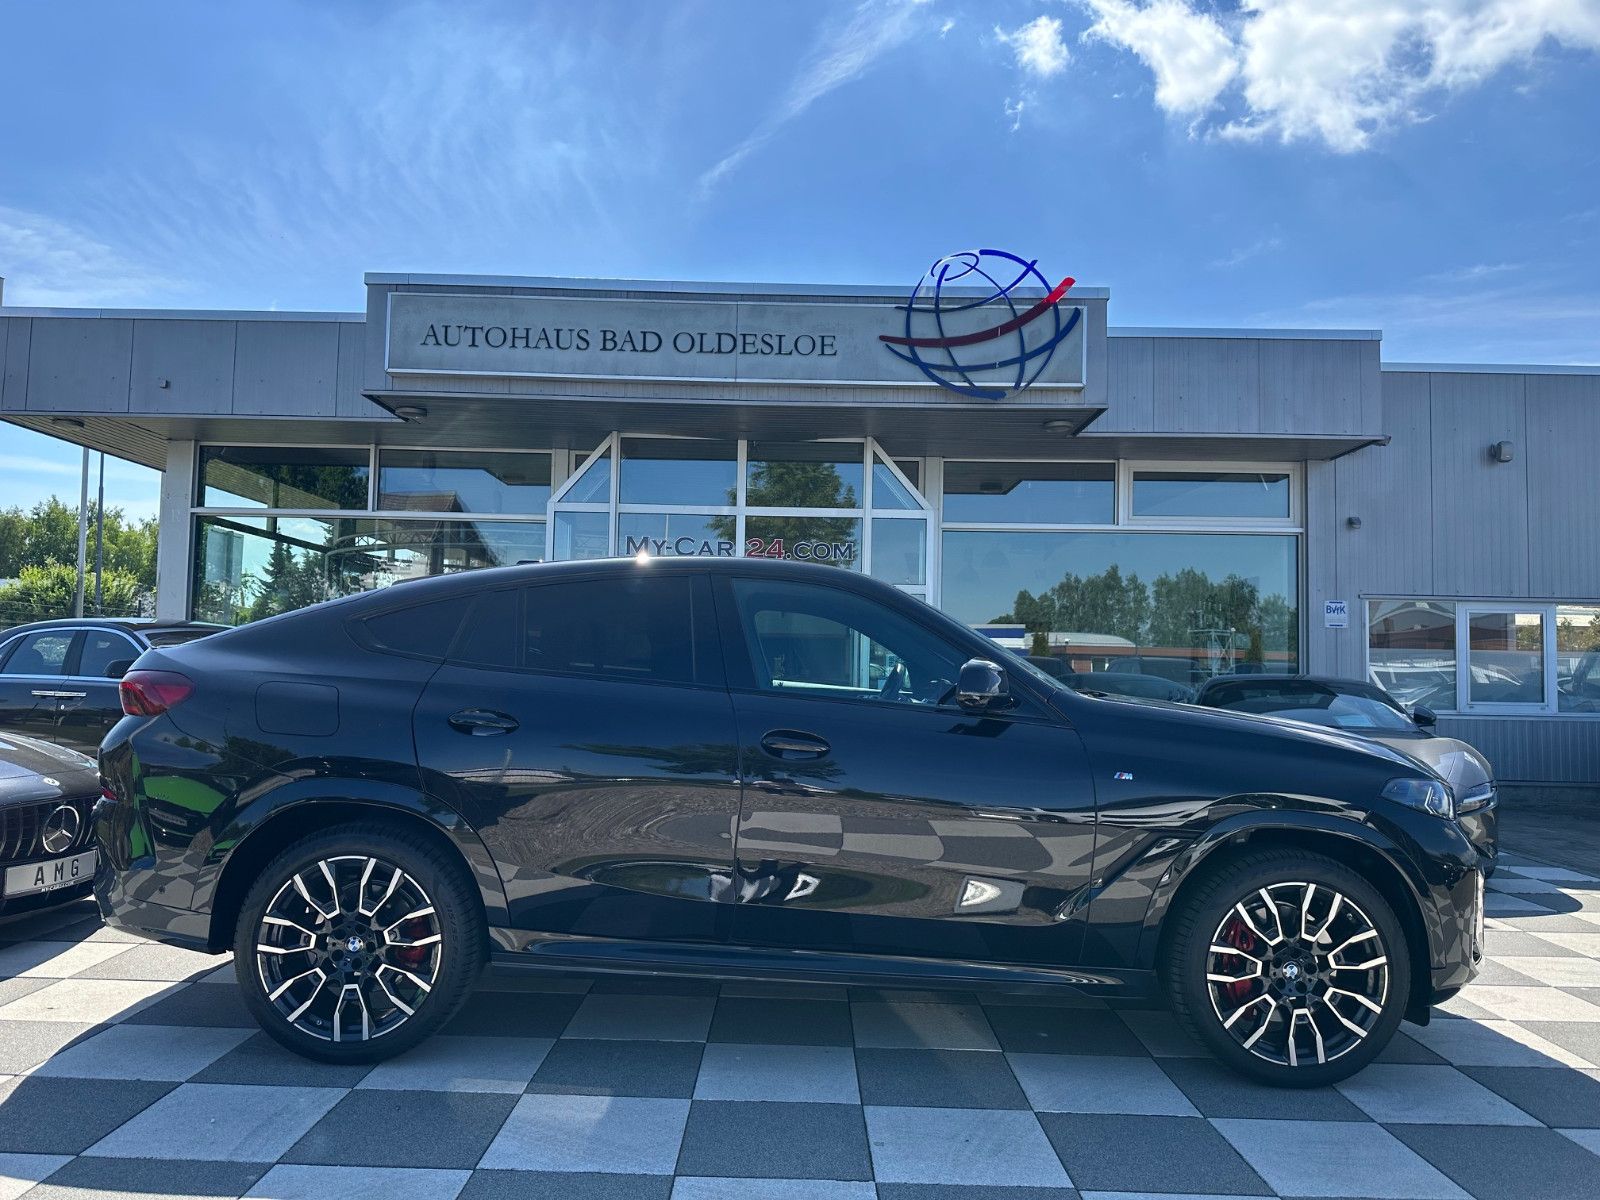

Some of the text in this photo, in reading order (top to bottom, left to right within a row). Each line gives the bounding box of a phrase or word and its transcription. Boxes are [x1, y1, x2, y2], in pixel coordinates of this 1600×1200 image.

[420, 324, 838, 357] AUTOHAUS BAD OLDESLOE
